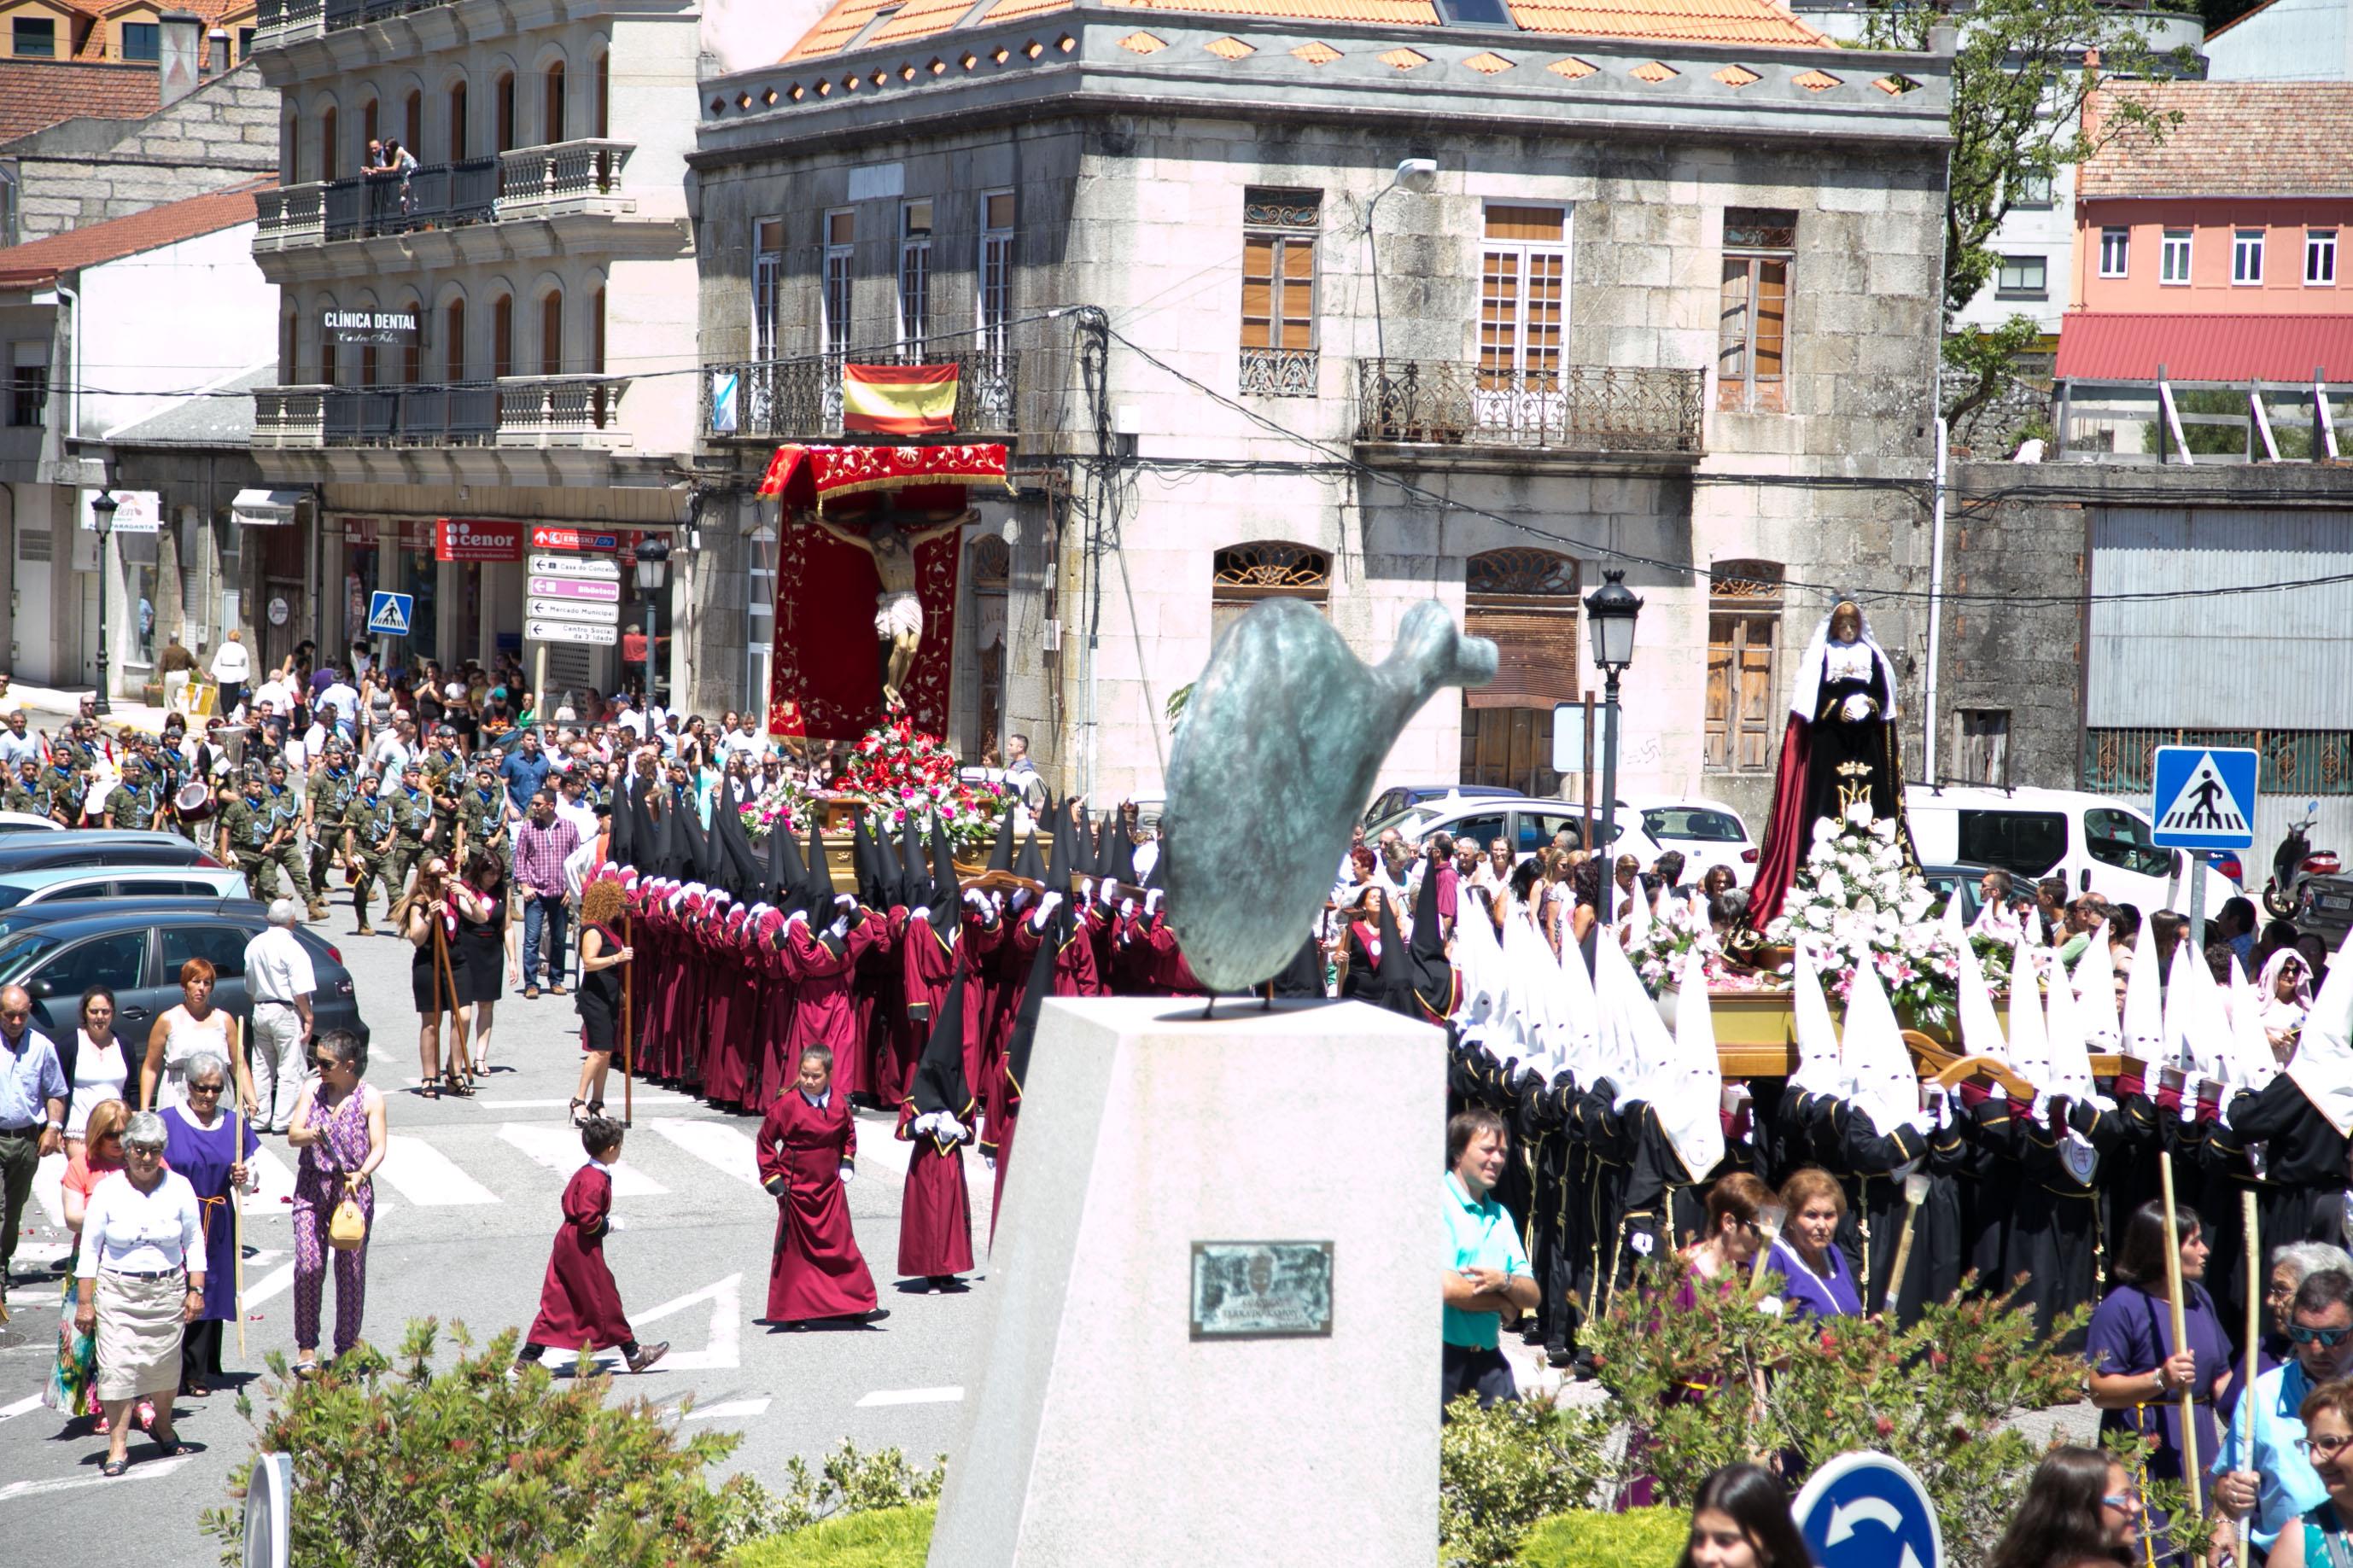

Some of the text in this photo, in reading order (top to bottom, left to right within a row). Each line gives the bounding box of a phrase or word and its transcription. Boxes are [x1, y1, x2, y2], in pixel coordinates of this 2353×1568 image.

[324, 310, 417, 330] CLÍNICA DENTAL
[459, 534, 514, 546] cenor
[563, 534, 593, 544] EROSKI
[578, 586, 616, 595] Biblioteca
[581, 608, 615, 616] Municipal
